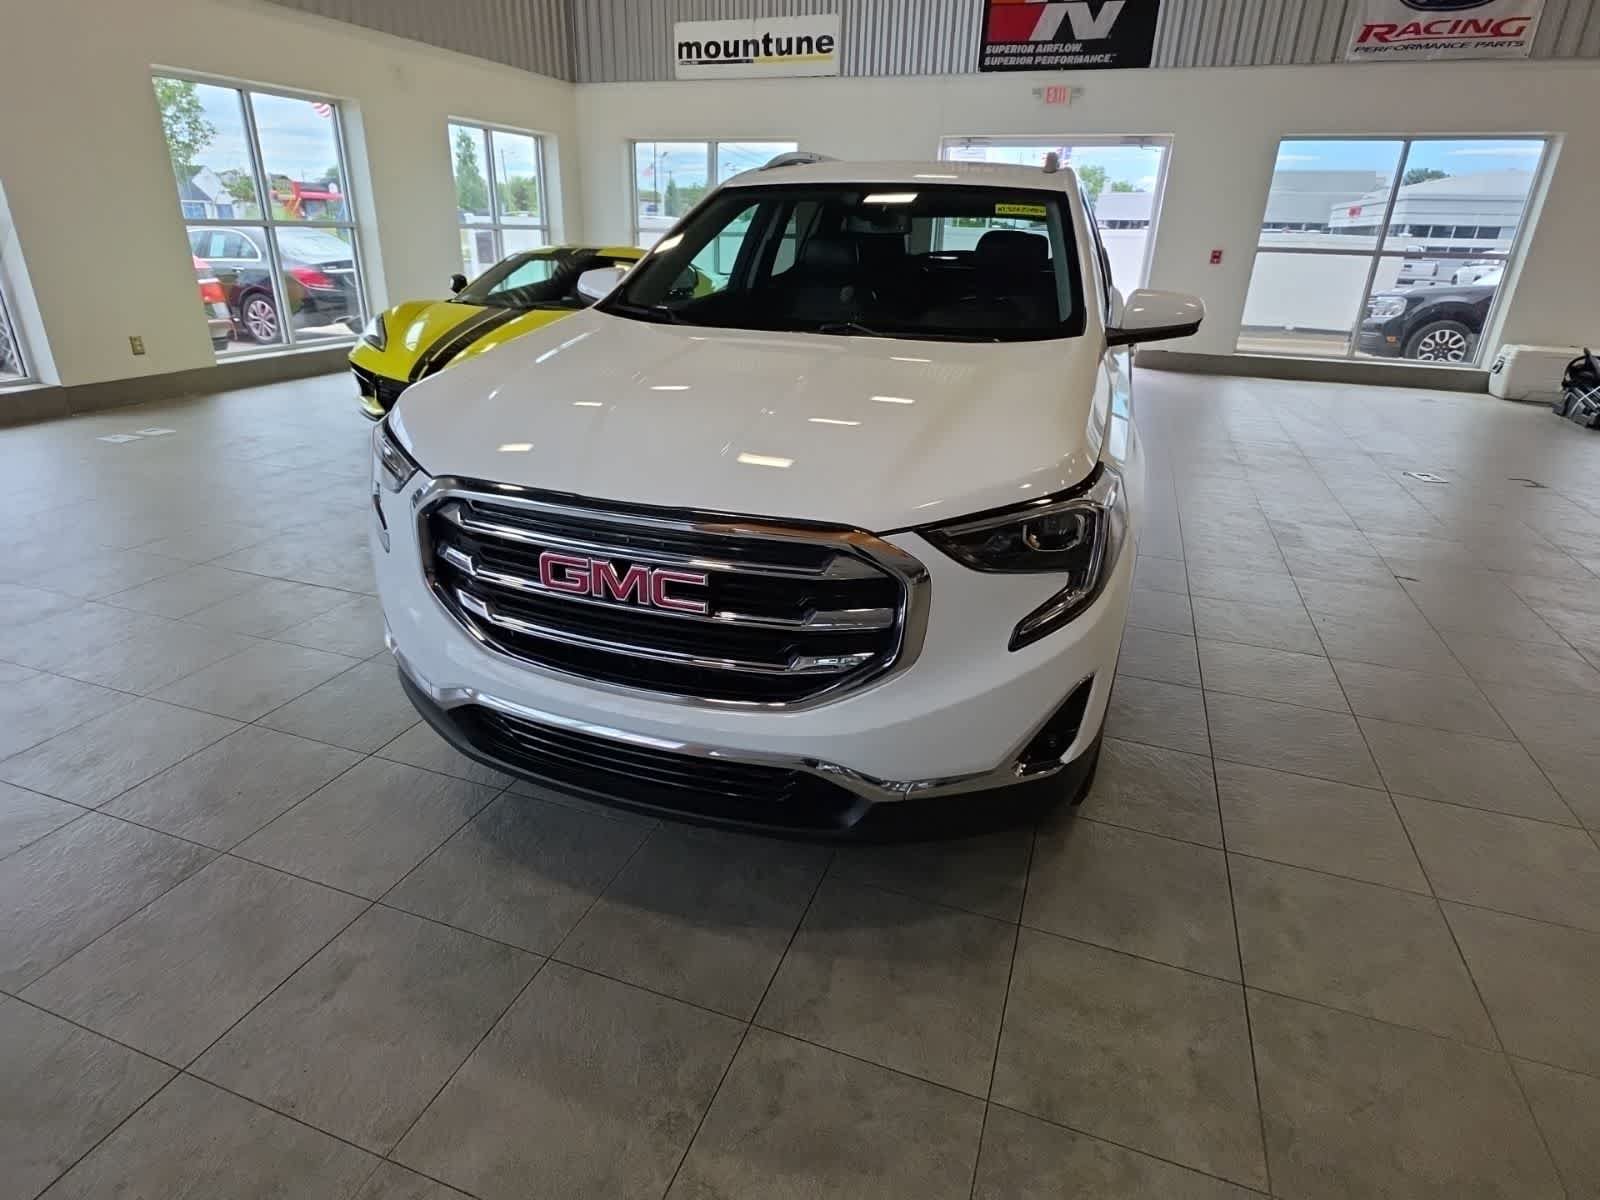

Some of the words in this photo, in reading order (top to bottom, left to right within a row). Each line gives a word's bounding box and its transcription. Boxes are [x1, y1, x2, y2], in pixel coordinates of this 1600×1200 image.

[1356, 16, 1532, 43] RACING
[677, 32, 835, 60] mountune
[985, 44, 1034, 54] SUPERIOR
[1354, 41, 1472, 53] PERFORMANCE
[1474, 40, 1526, 49] PARTS
[984, 56, 1033, 66] SUPERIOR
[1046, 87, 1067, 104] EXIT
[539, 551, 709, 614] GMC
